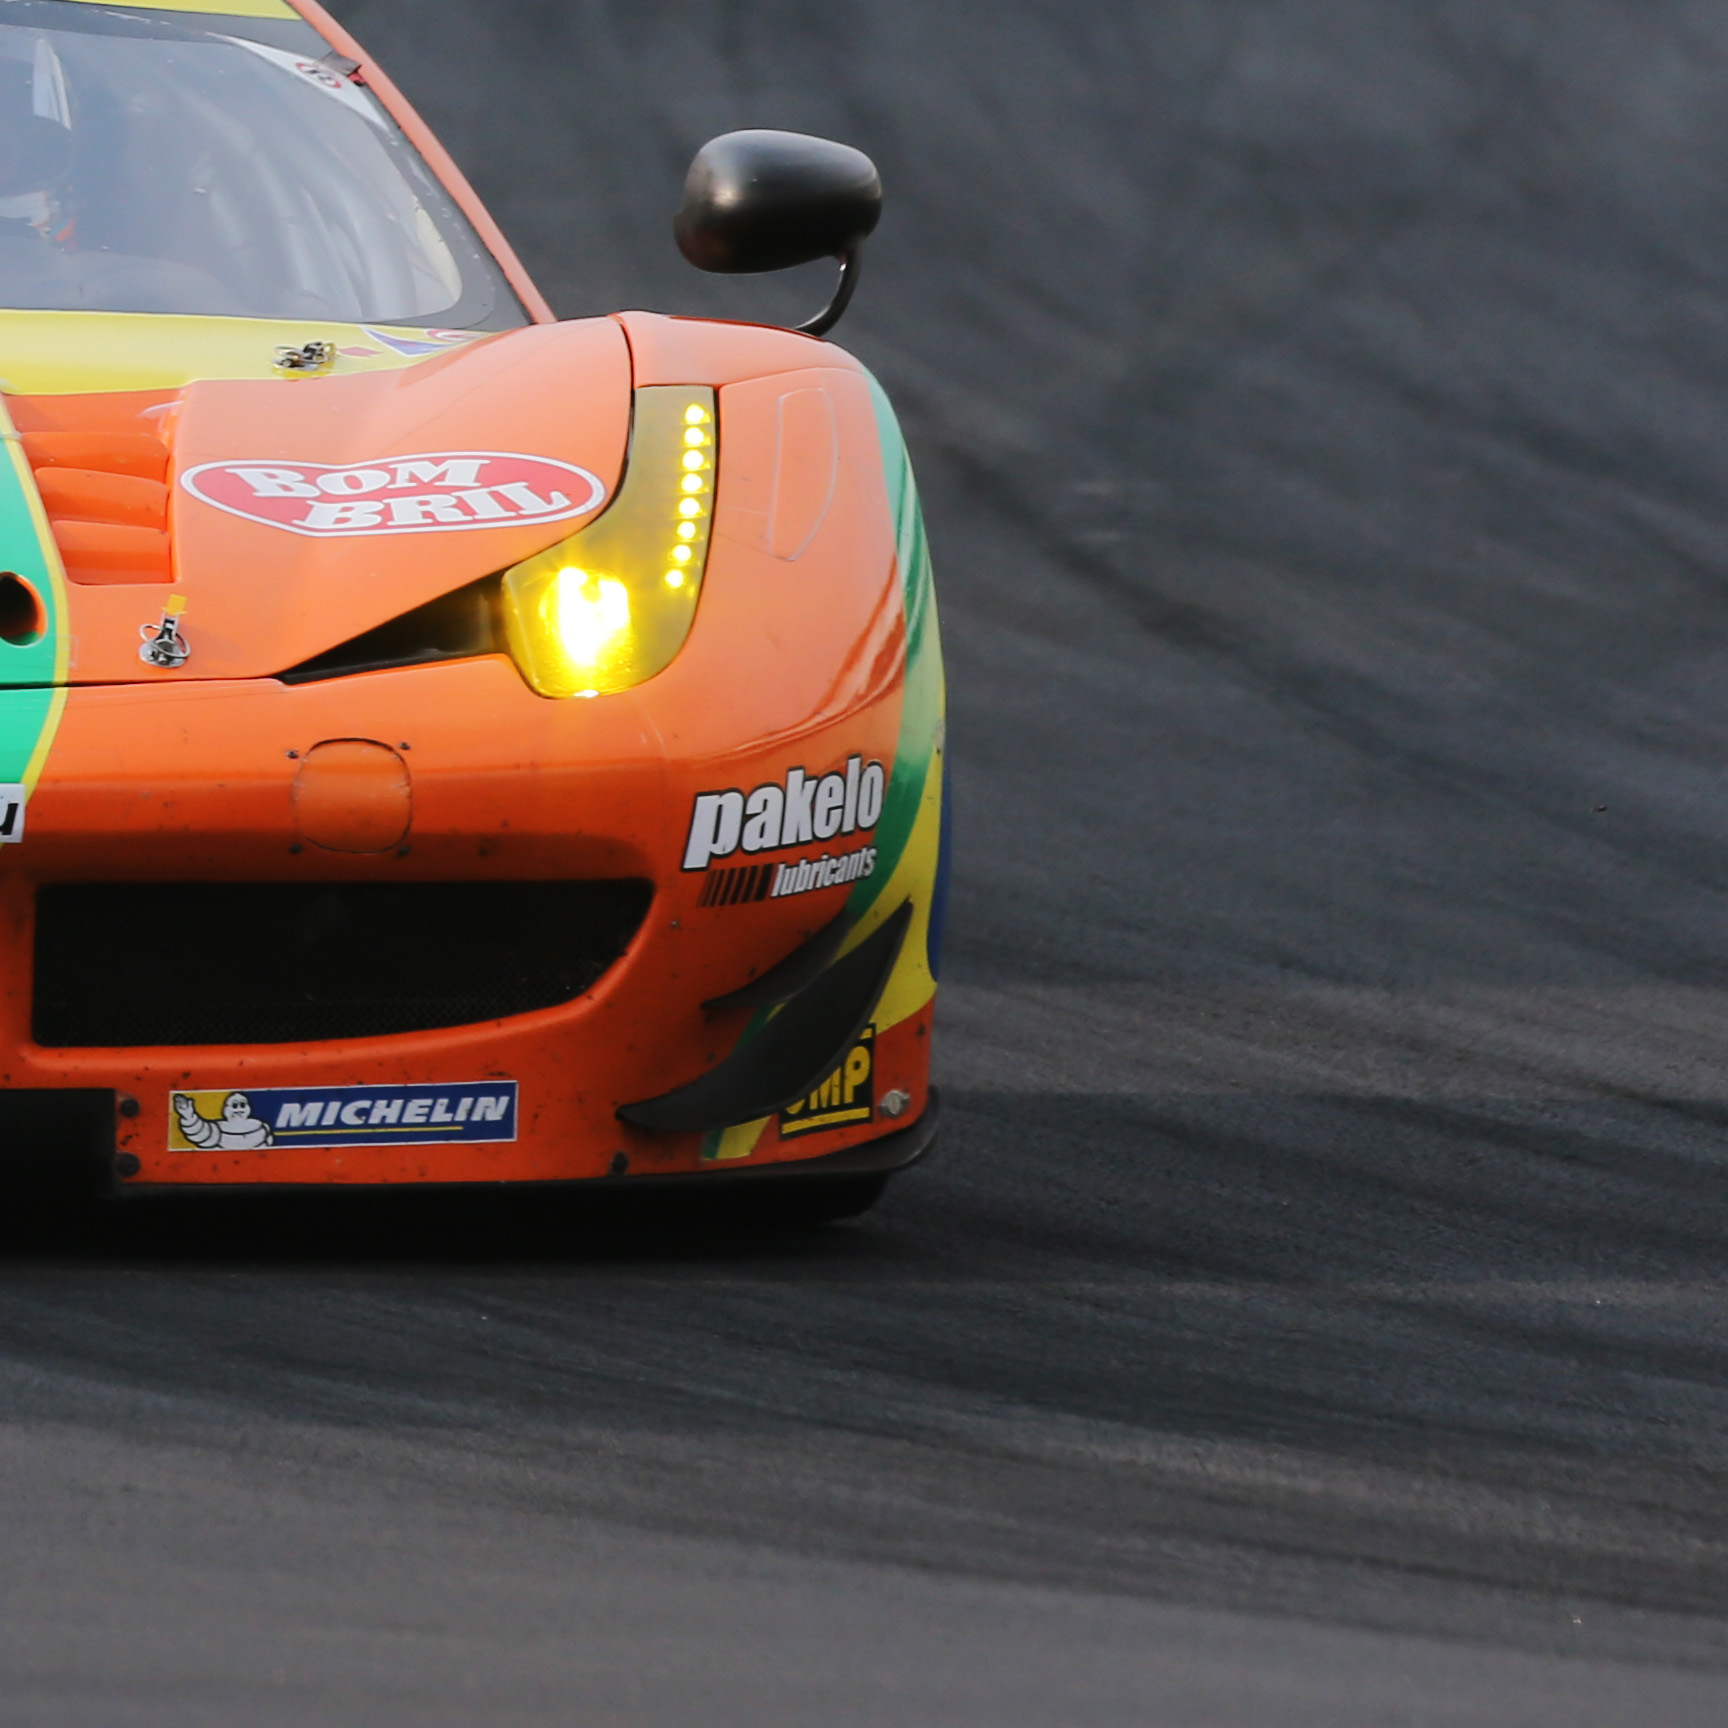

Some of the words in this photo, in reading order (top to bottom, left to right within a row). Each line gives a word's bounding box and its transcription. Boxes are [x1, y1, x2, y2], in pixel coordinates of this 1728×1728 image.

[225, 459, 491, 499] BOM
[292, 481, 572, 529] BRIL
[680, 753, 886, 872] pakelo
[770, 845, 879, 899] lubricants
[275, 1095, 511, 1129] MICHELIN
